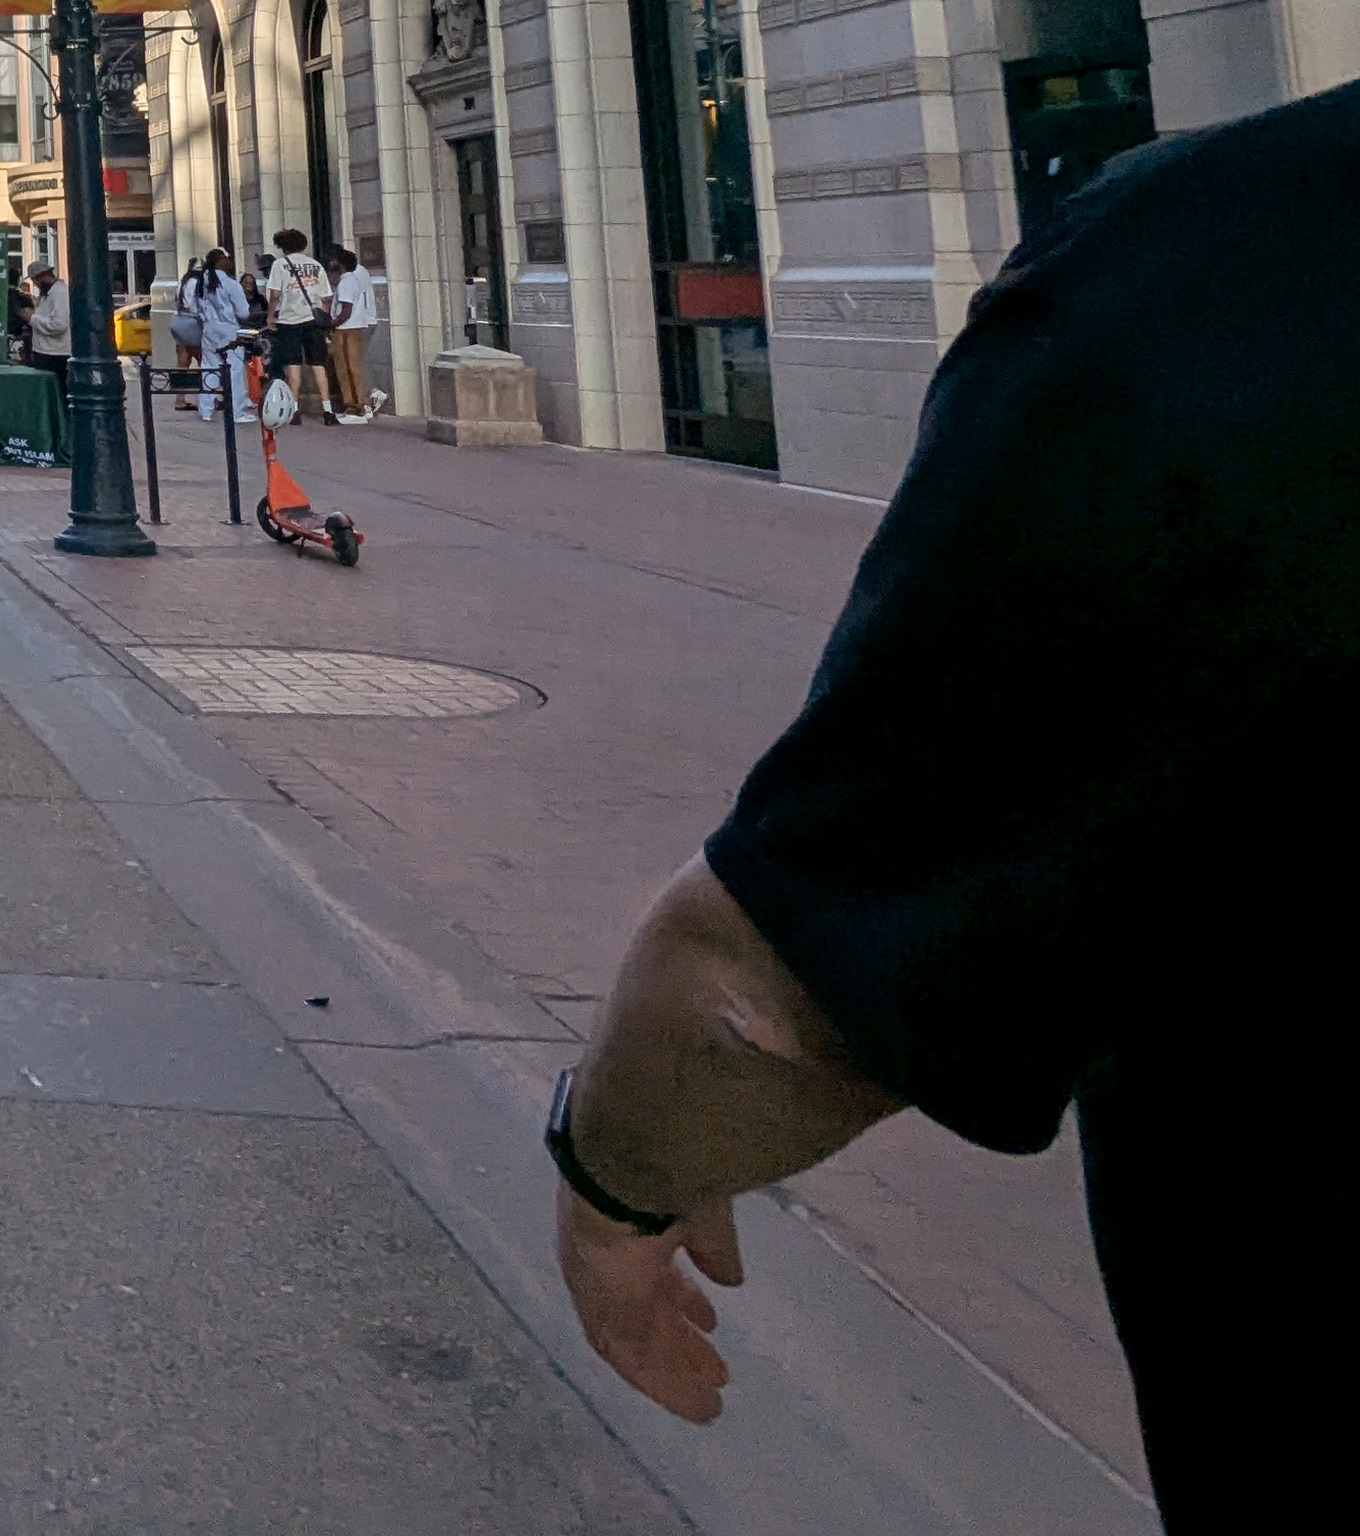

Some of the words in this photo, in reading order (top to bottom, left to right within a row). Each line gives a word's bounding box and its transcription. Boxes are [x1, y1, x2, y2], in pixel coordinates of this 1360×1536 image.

[8, 438, 29, 447] ASK
[4, 447, 23, 456] OUT
[24, 449, 55, 461] ISLAM
